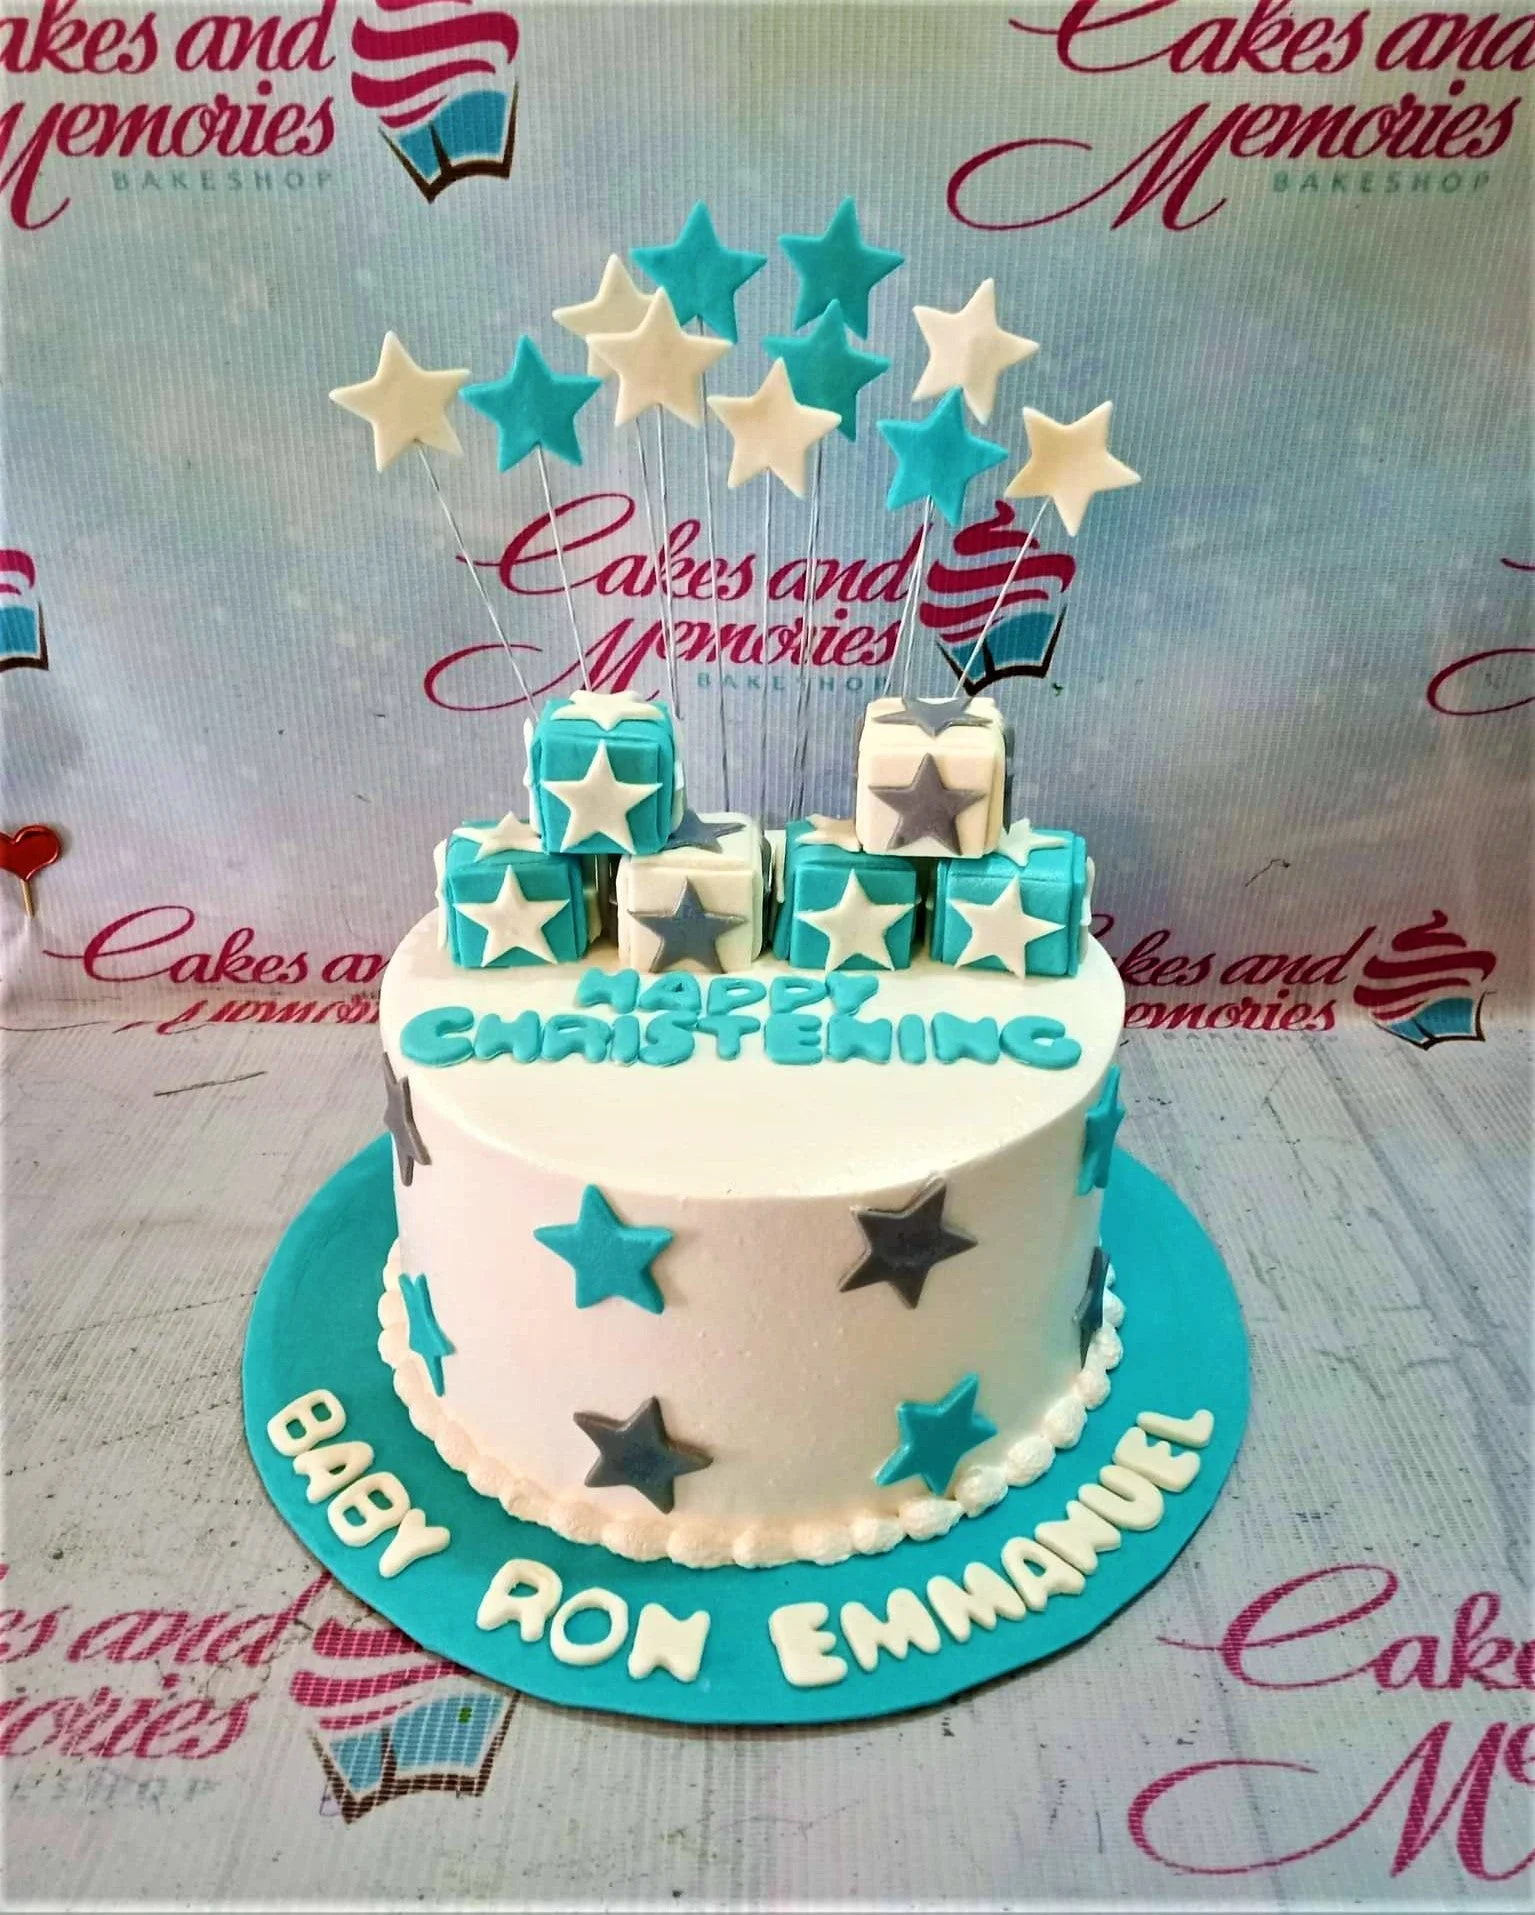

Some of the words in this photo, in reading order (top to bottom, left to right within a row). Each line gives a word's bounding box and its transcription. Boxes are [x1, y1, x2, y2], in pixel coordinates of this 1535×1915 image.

[0, 0, 157, 74] akes
[175, 0, 337, 71] and
[111, 169, 334, 191] BAKESHOP
[947, 80, 1522, 231] Memories
[1273, 170, 1490, 194] BAKESHOP
[456, 493, 754, 601] Cakes
[767, 522, 931, 602] and
[423, 608, 903, 711] Memories
[43, 906, 308, 984] Cakes
[1091, 914, 1216, 986] kes
[1220, 925, 1377, 985] and
[573, 967, 880, 1017] HAPPY
[1123, 988, 1337, 1031] emories
[400, 1005, 1082, 1069] CHRISTENING
[267, 1389, 451, 1578] BABY
[476, 1558, 711, 1684] RON
[768, 1408, 1215, 1687] EMMANUEL
[66, 1571, 334, 1667] and
[1156, 1563, 1535, 1690] Cak
[0, 1673, 259, 1760] ories
